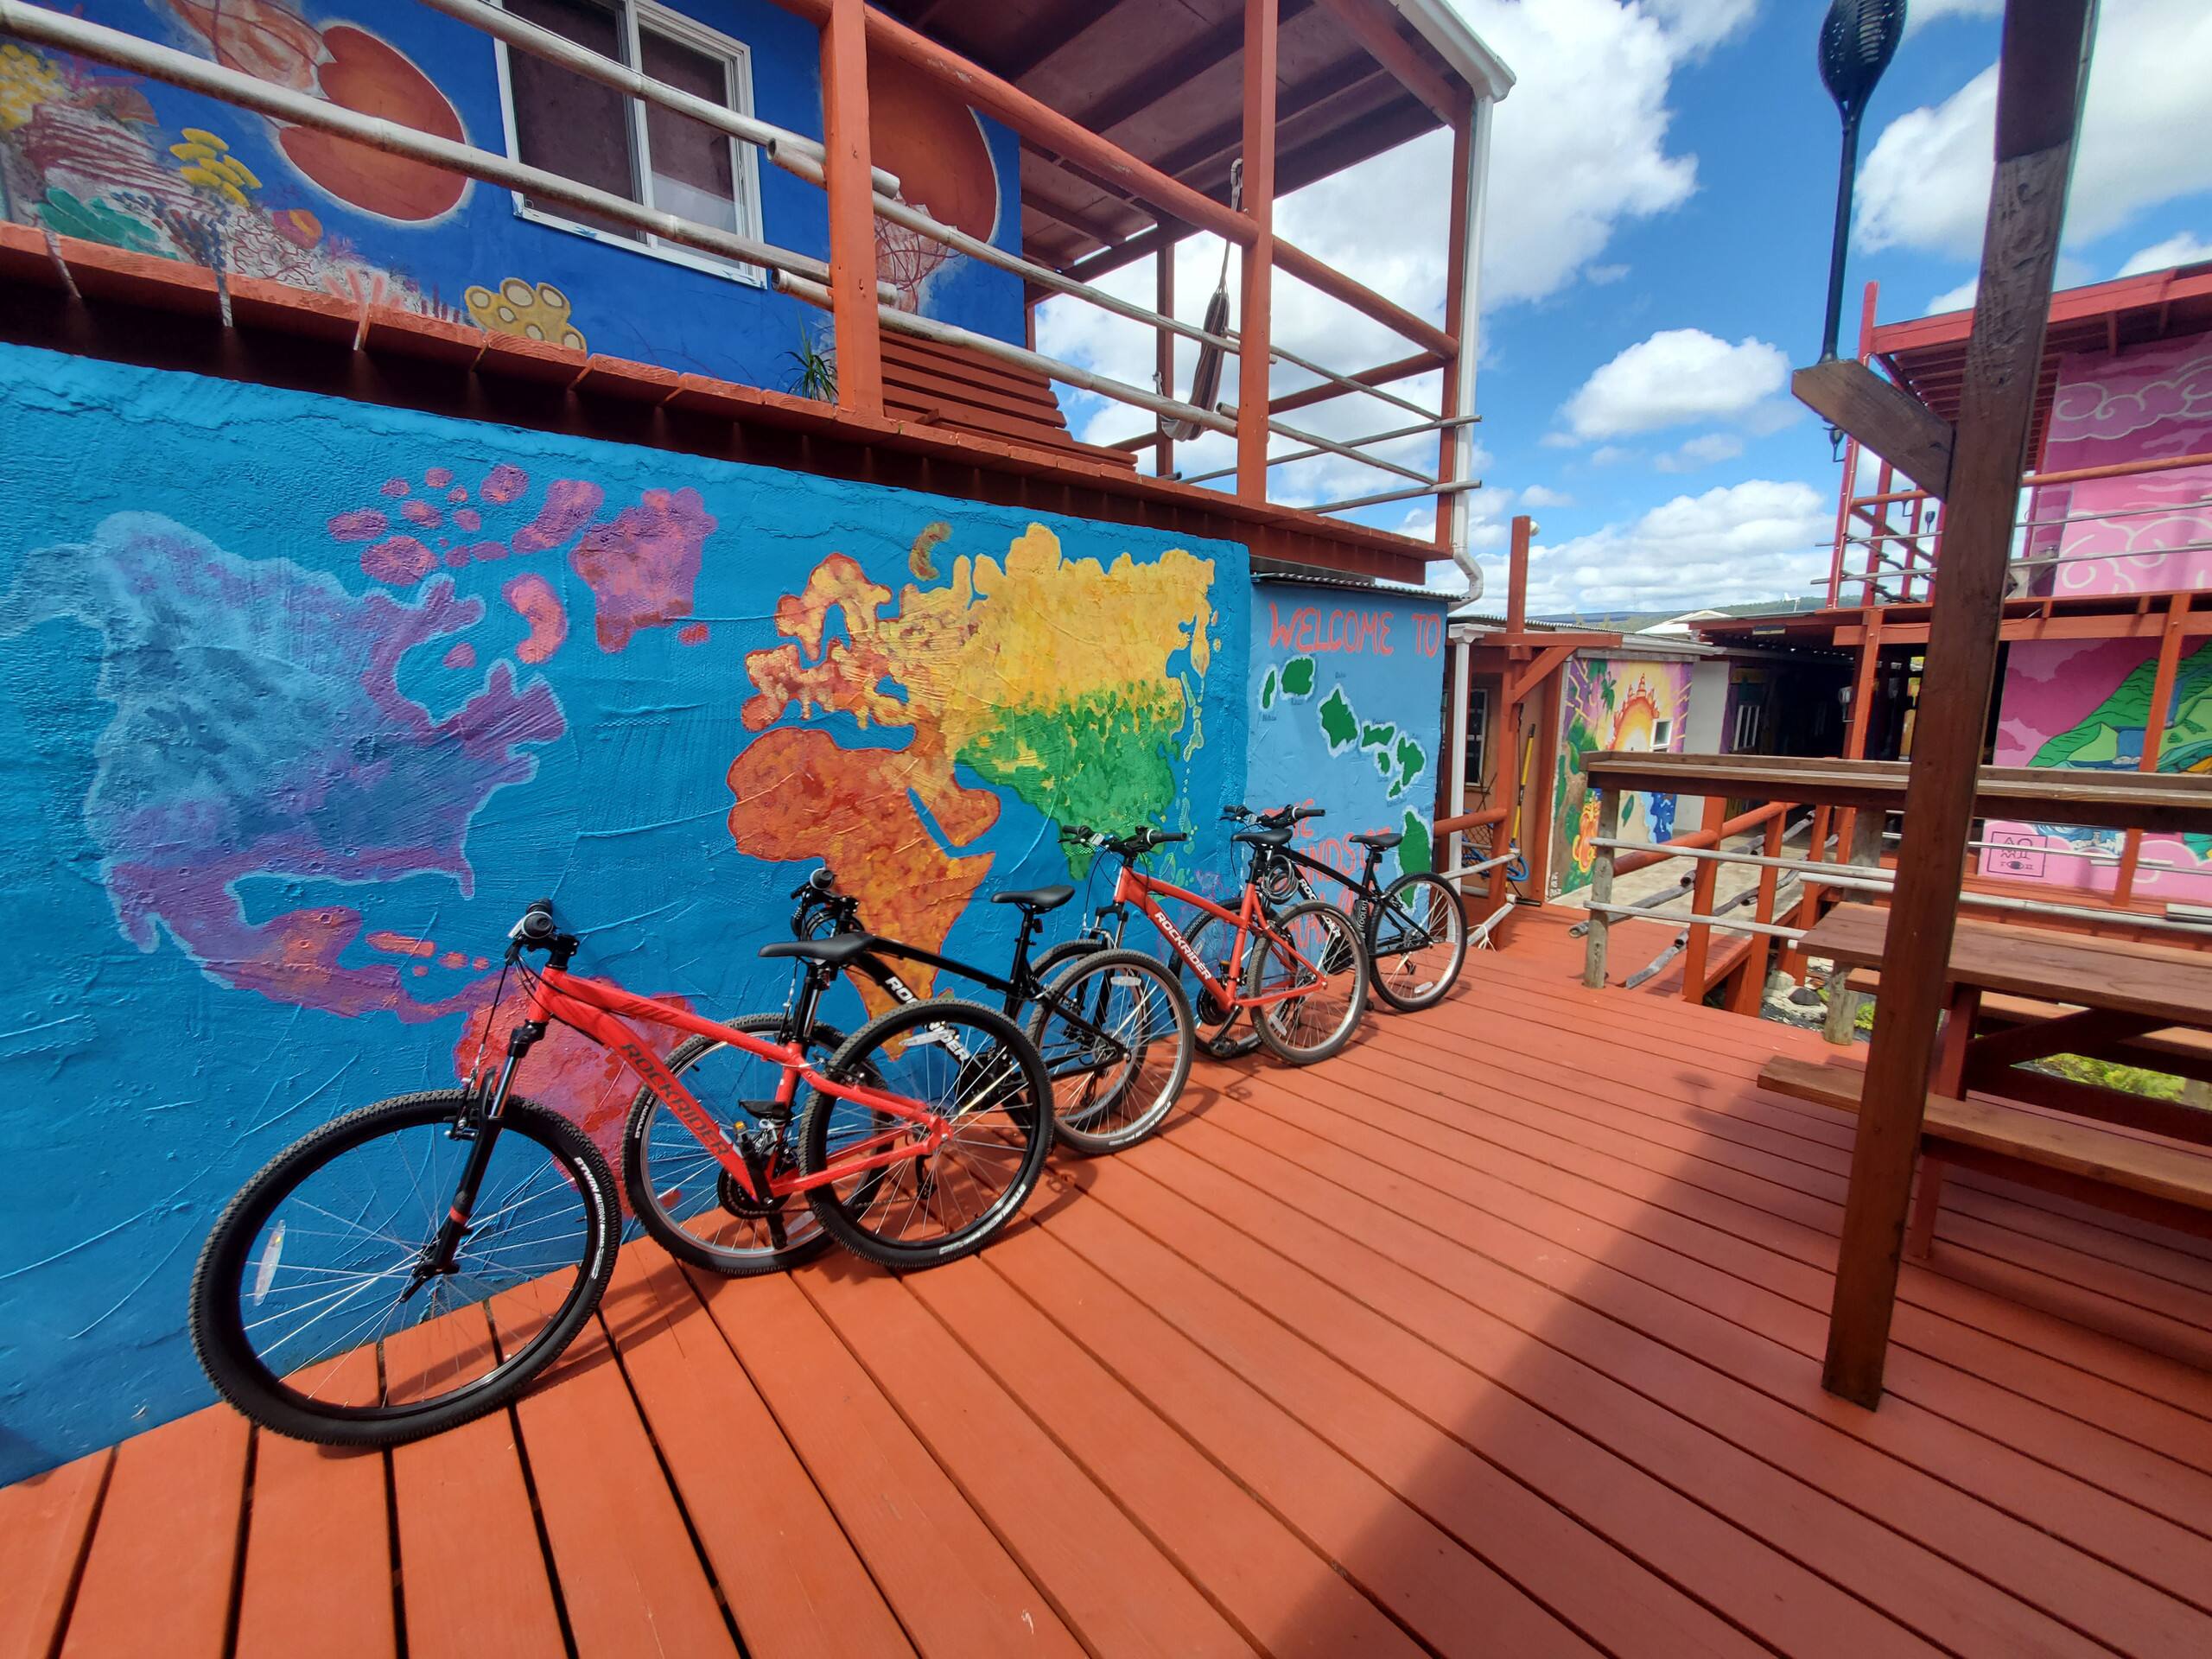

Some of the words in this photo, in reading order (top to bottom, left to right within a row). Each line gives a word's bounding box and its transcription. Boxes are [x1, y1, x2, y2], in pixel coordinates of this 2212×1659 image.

[1269, 601, 1394, 655] WELCOME
[1411, 613, 1441, 658] TO
[1154, 912, 1211, 980] ROCKRIDER
[621, 1043, 729, 1155] ROCKRIDER
